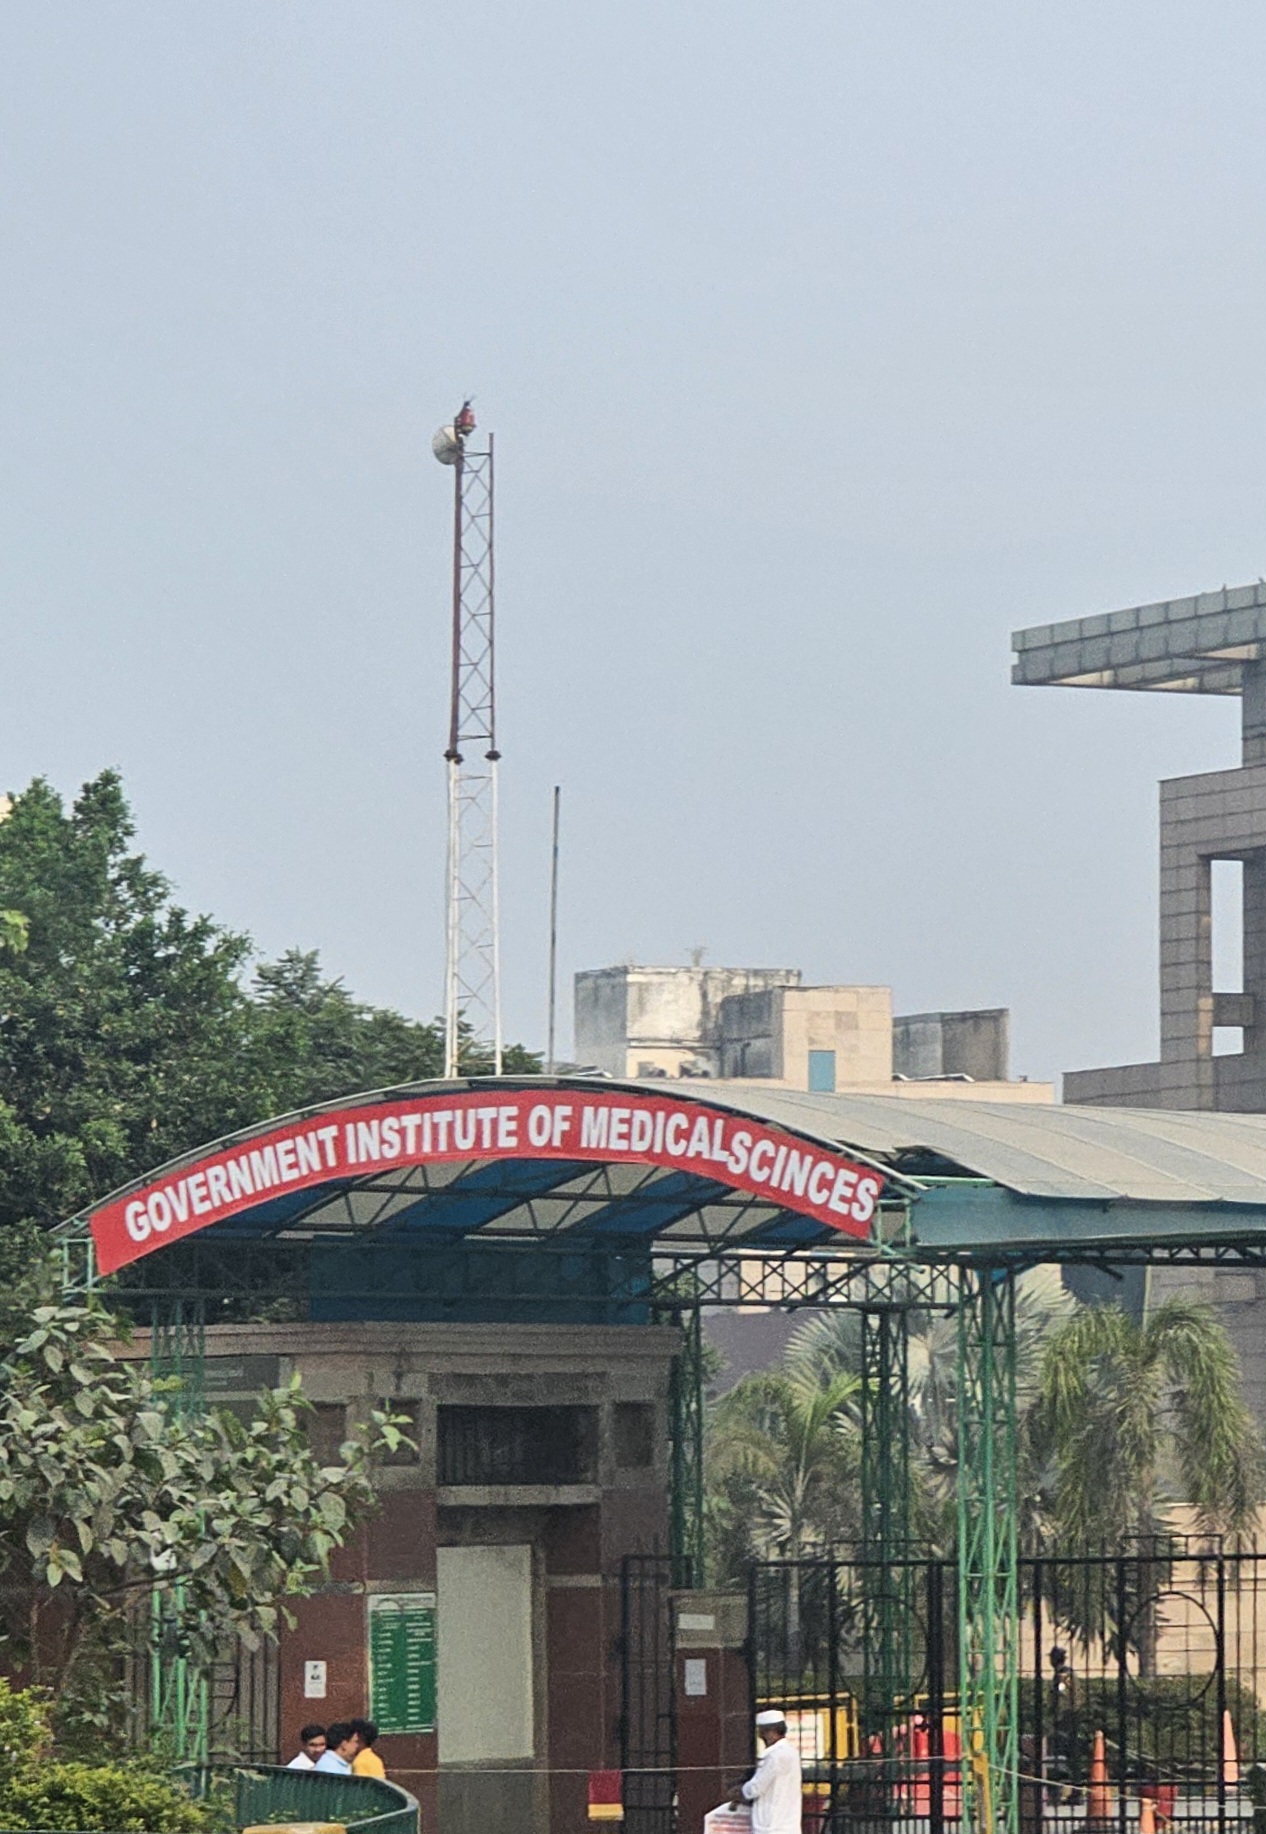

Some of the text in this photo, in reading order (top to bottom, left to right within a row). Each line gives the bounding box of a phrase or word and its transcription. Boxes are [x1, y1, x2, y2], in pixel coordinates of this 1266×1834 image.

[124, 1125, 338, 1242] GOVERNMENT
[345, 1105, 518, 1163] INSTITUTE
[527, 1103, 572, 1148] OF
